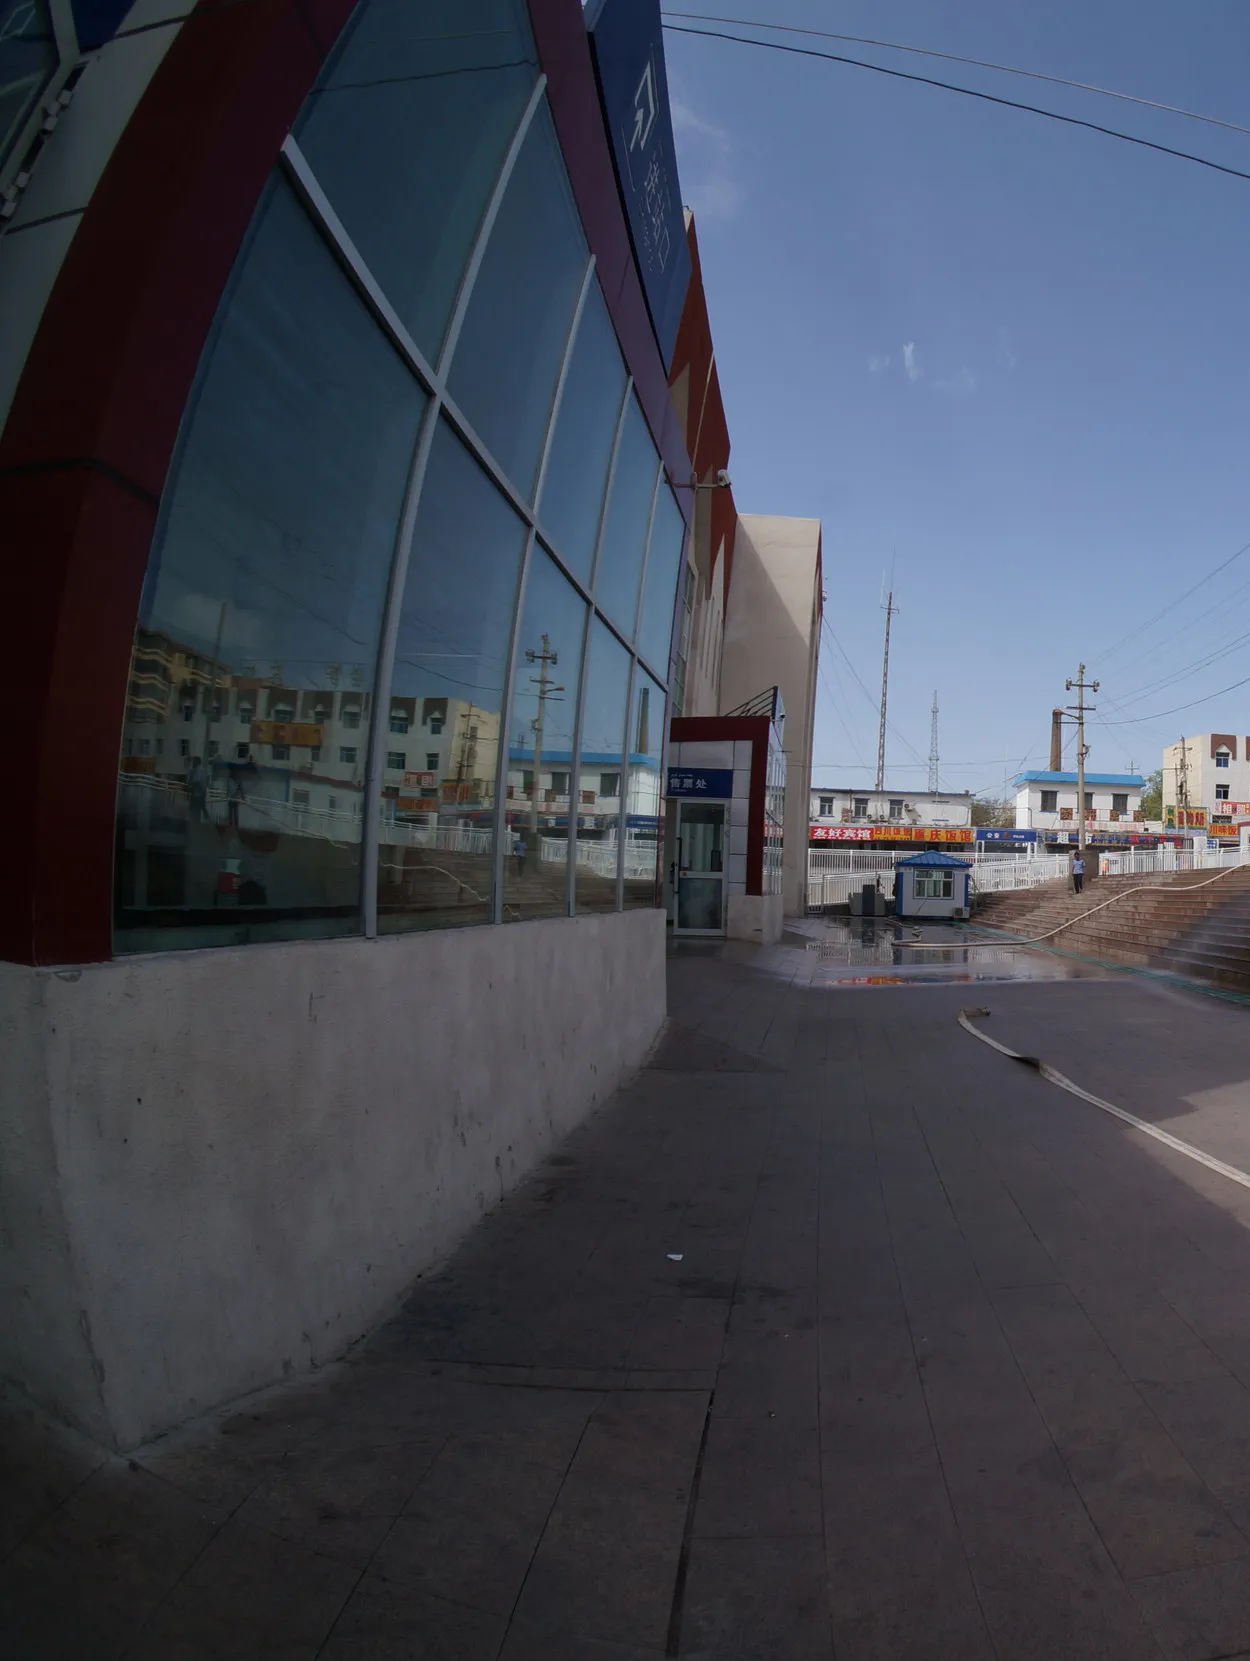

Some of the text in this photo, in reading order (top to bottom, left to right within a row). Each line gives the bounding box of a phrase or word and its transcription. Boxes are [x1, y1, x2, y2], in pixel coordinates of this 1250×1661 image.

[670, 778, 708, 789] 售票处
[813, 827, 871, 839] 友好宾馆
[914, 828, 972, 842] 重庆饭馆
